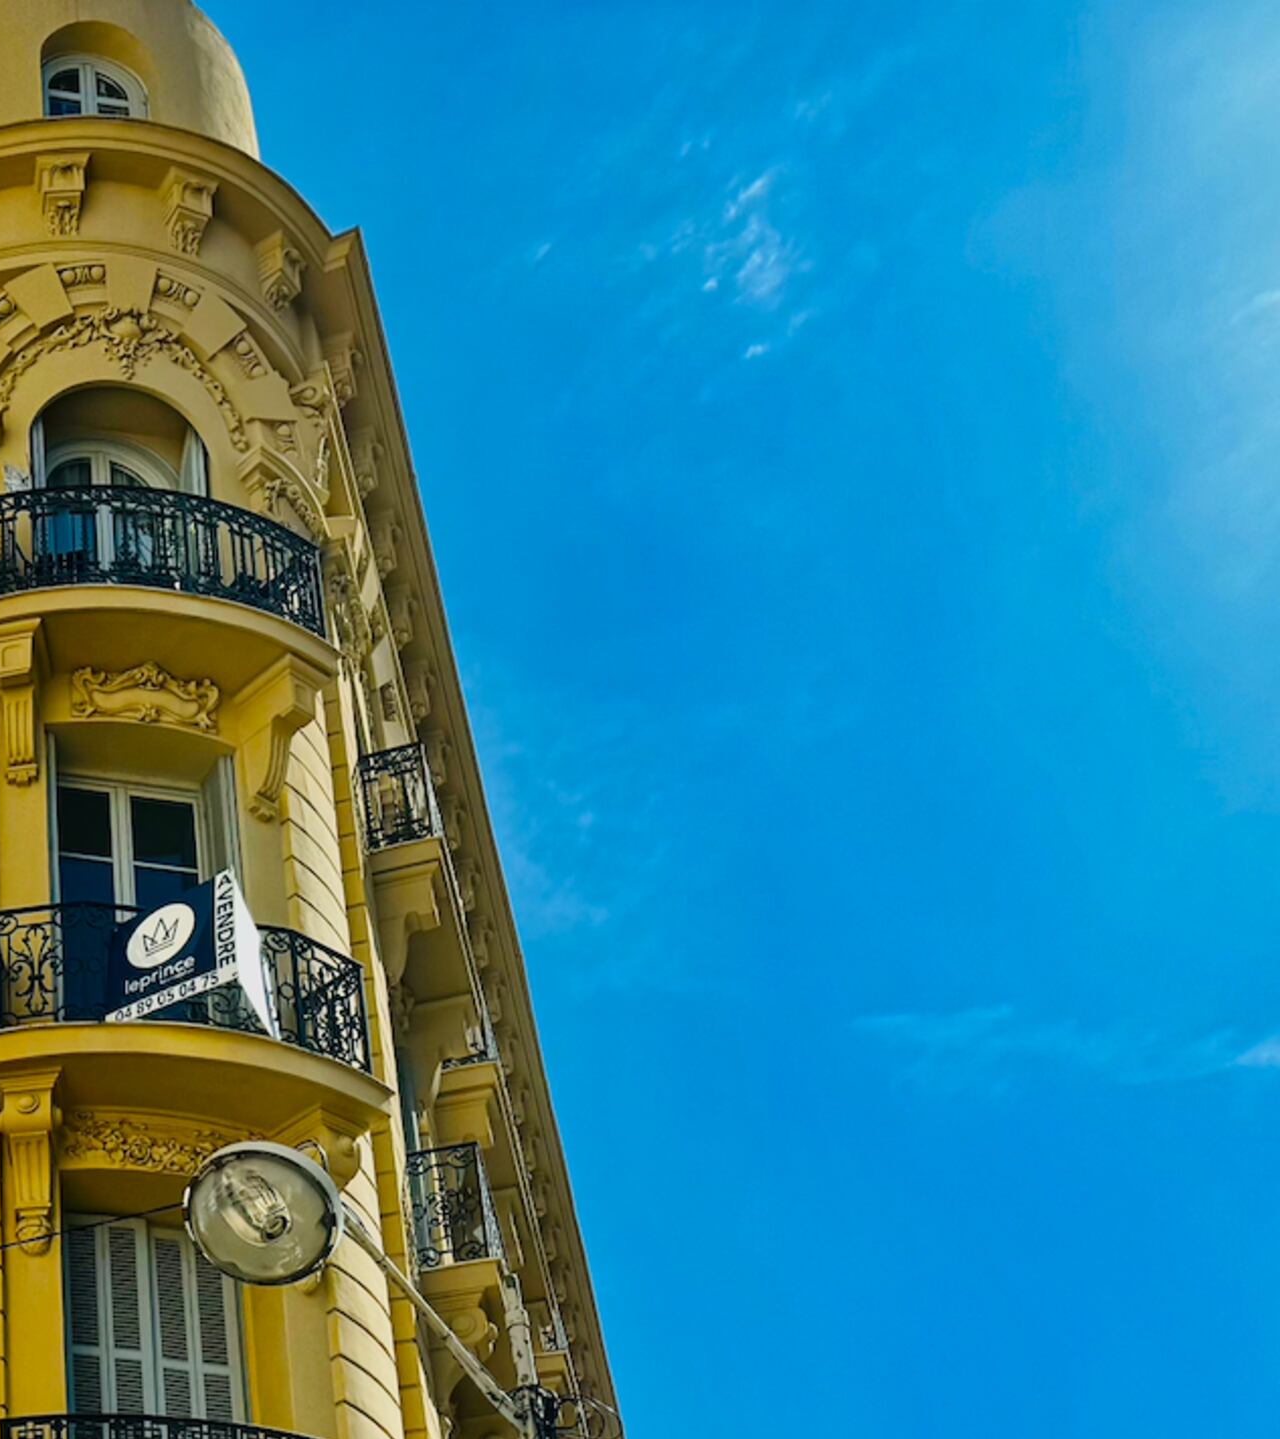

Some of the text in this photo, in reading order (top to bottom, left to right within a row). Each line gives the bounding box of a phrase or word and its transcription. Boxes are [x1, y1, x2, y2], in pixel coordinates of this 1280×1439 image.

[217, 874, 236, 968] A VENDRE
[124, 955, 196, 995] leprince
